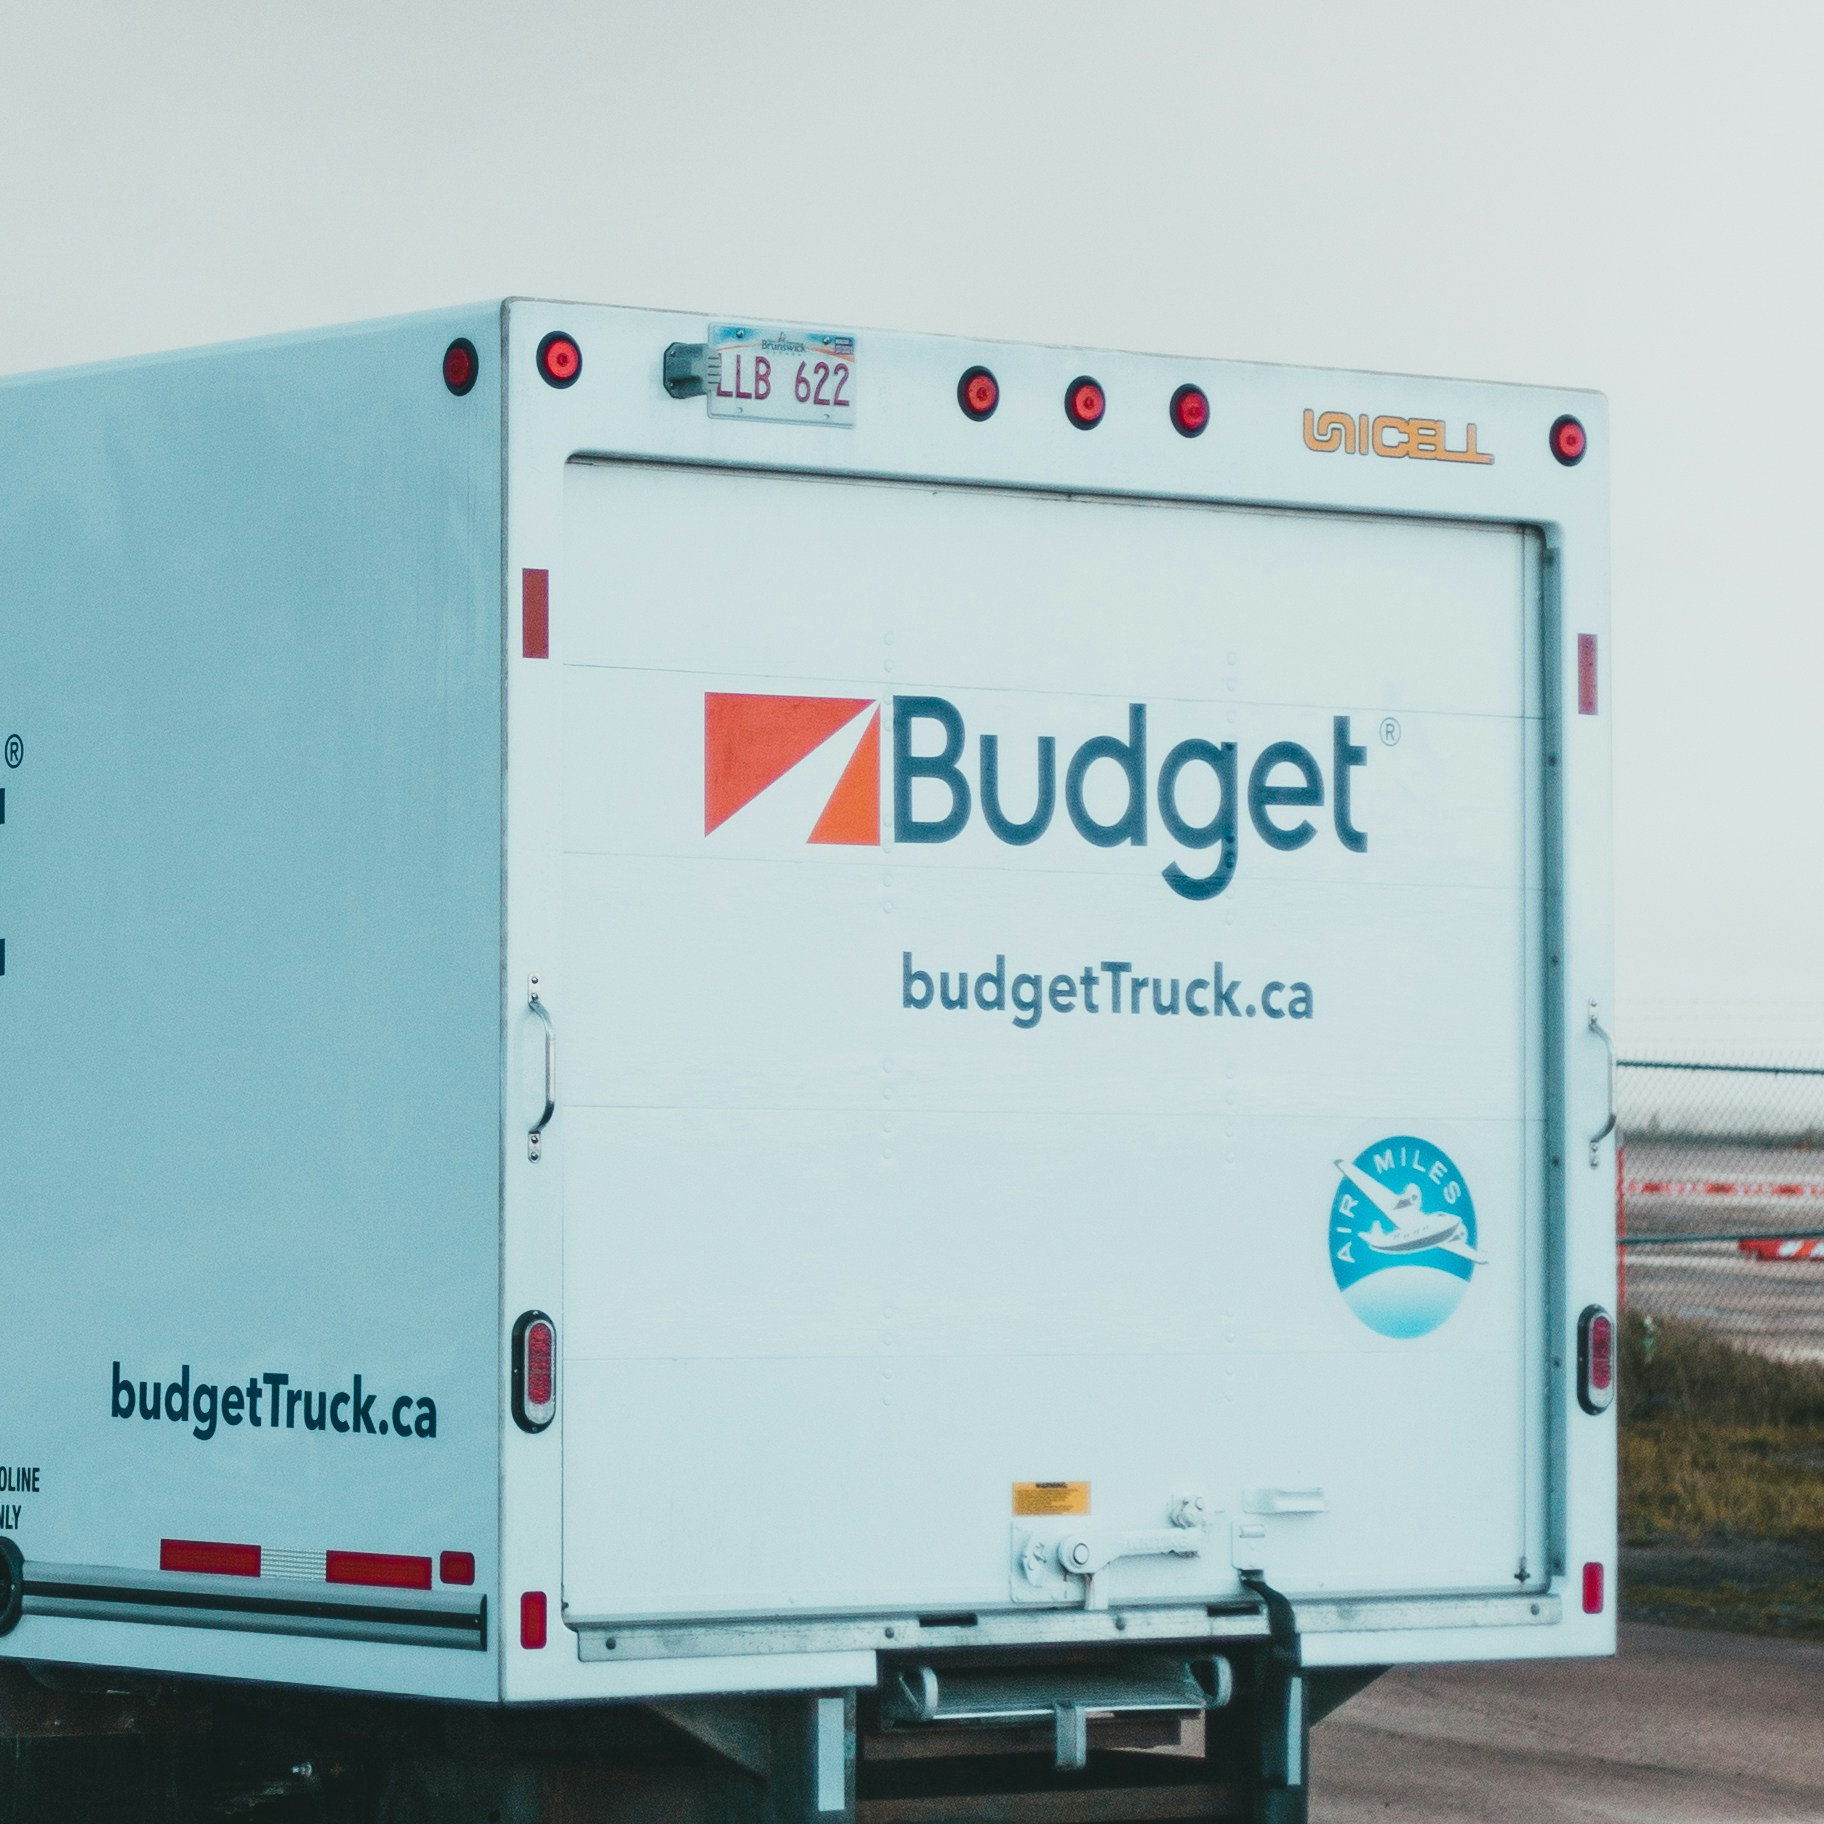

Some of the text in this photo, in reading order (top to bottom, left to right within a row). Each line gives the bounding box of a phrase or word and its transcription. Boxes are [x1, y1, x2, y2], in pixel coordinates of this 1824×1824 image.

[716, 354, 851, 407] LLB 622
[1302, 408, 1496, 466] UNICELL
[892, 694, 1368, 901] Budget
[902, 951, 1315, 1030] budgetTruck.ca
[1336, 1146, 1462, 1264] AIR MILES
[111, 1360, 438, 1441] budgetTruck.ca
